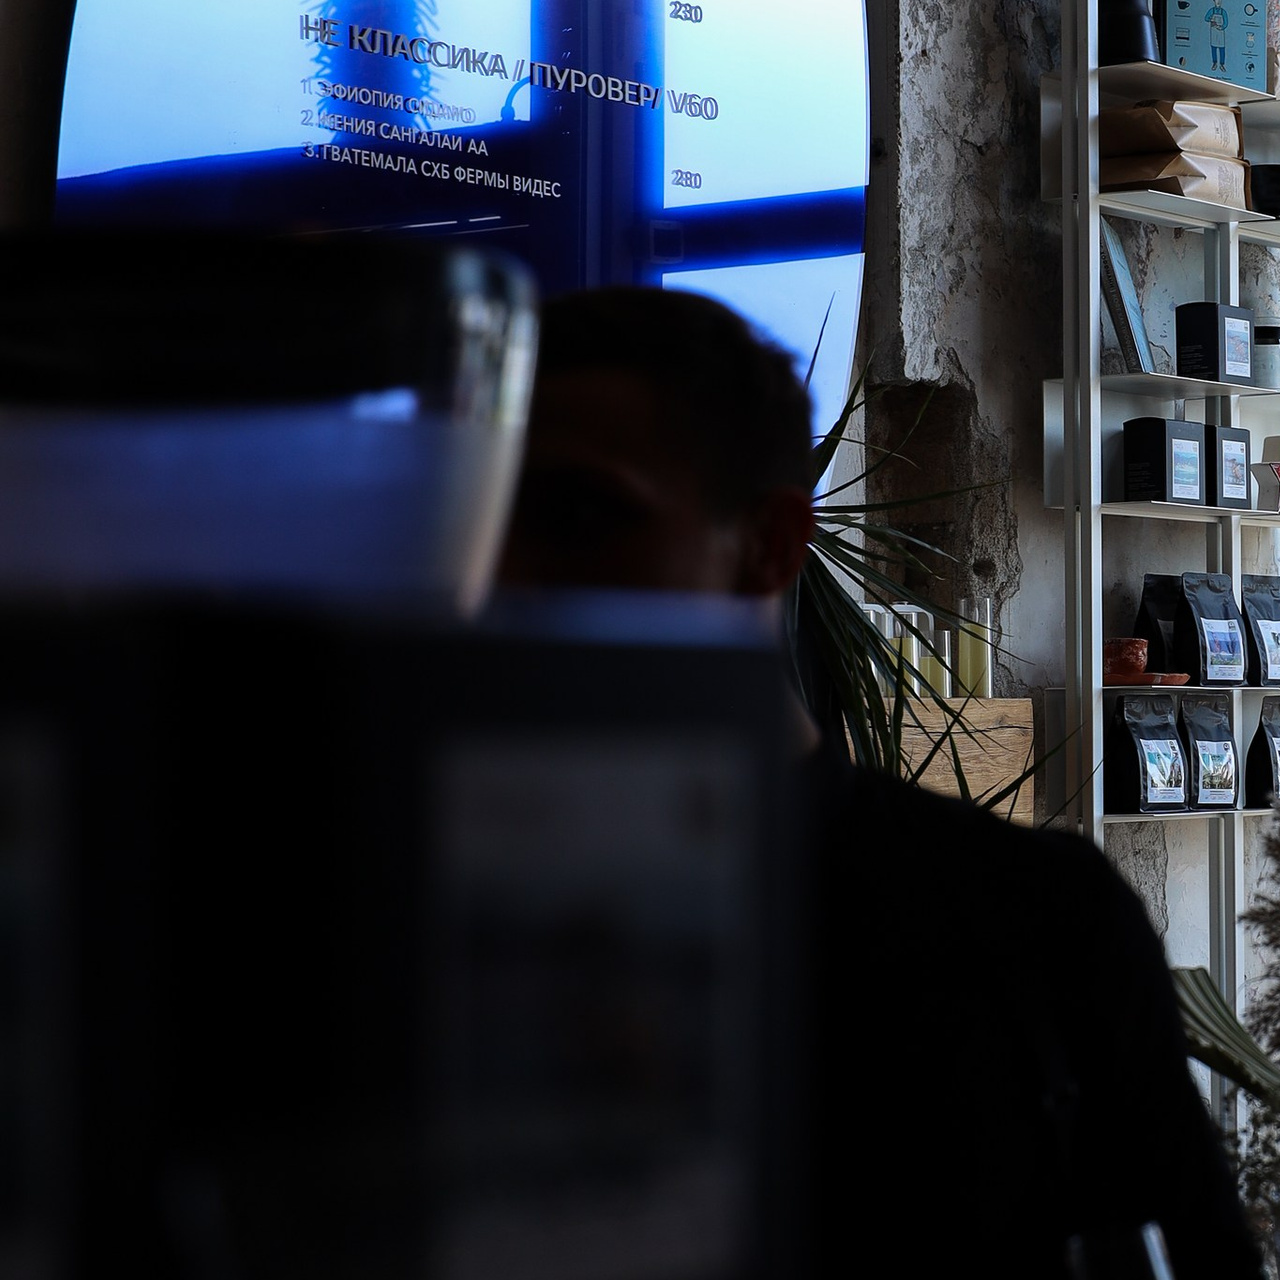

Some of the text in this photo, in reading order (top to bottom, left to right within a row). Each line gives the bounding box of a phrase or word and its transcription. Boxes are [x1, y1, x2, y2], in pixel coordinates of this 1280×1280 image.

[669, 0, 703, 23] 230
[300, 15, 343, 47] НЕ
[348, 24, 509, 80] КЛАССИКА
[666, 89, 719, 121] V60
[316, 81, 404, 112] ЭФИОПИЯ
[318, 111, 376, 136] КЕНИЯ
[467, 138, 489, 157] АА
[322, 144, 418, 175] ГВАТЕМАЛА
[421, 160, 450, 180] СХБ
[454, 165, 510, 190] ФЕРМЫ
[513, 175, 562, 198] ВИДЕС
